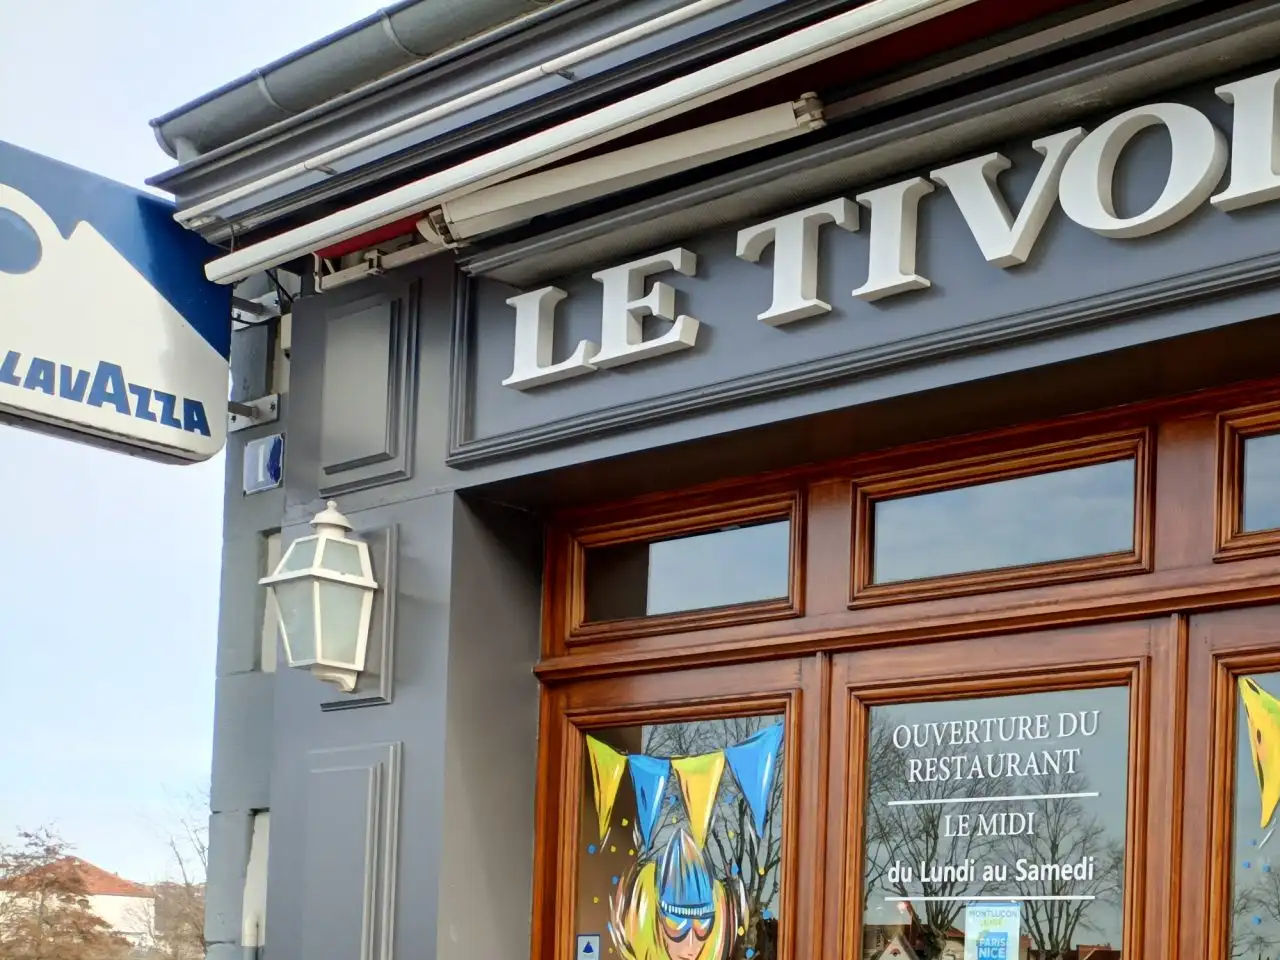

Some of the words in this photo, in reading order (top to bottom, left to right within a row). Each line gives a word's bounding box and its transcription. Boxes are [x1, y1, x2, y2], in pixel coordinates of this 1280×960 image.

[501, 247, 700, 392] LE
[0, 349, 212, 439] LAVAZZA
[892, 714, 1050, 749] OUVERTURE
[1057, 710, 1100, 738] DU
[908, 748, 1081, 783] RESTAURANT
[943, 814, 970, 838] LE
[976, 812, 1035, 837] MIDI
[887, 860, 912, 883] du
[920, 858, 975, 883] Lundi
[982, 864, 1007, 882] au
[1015, 856, 1094, 882] Samedi
[978, 947, 1006, 959] NICE
